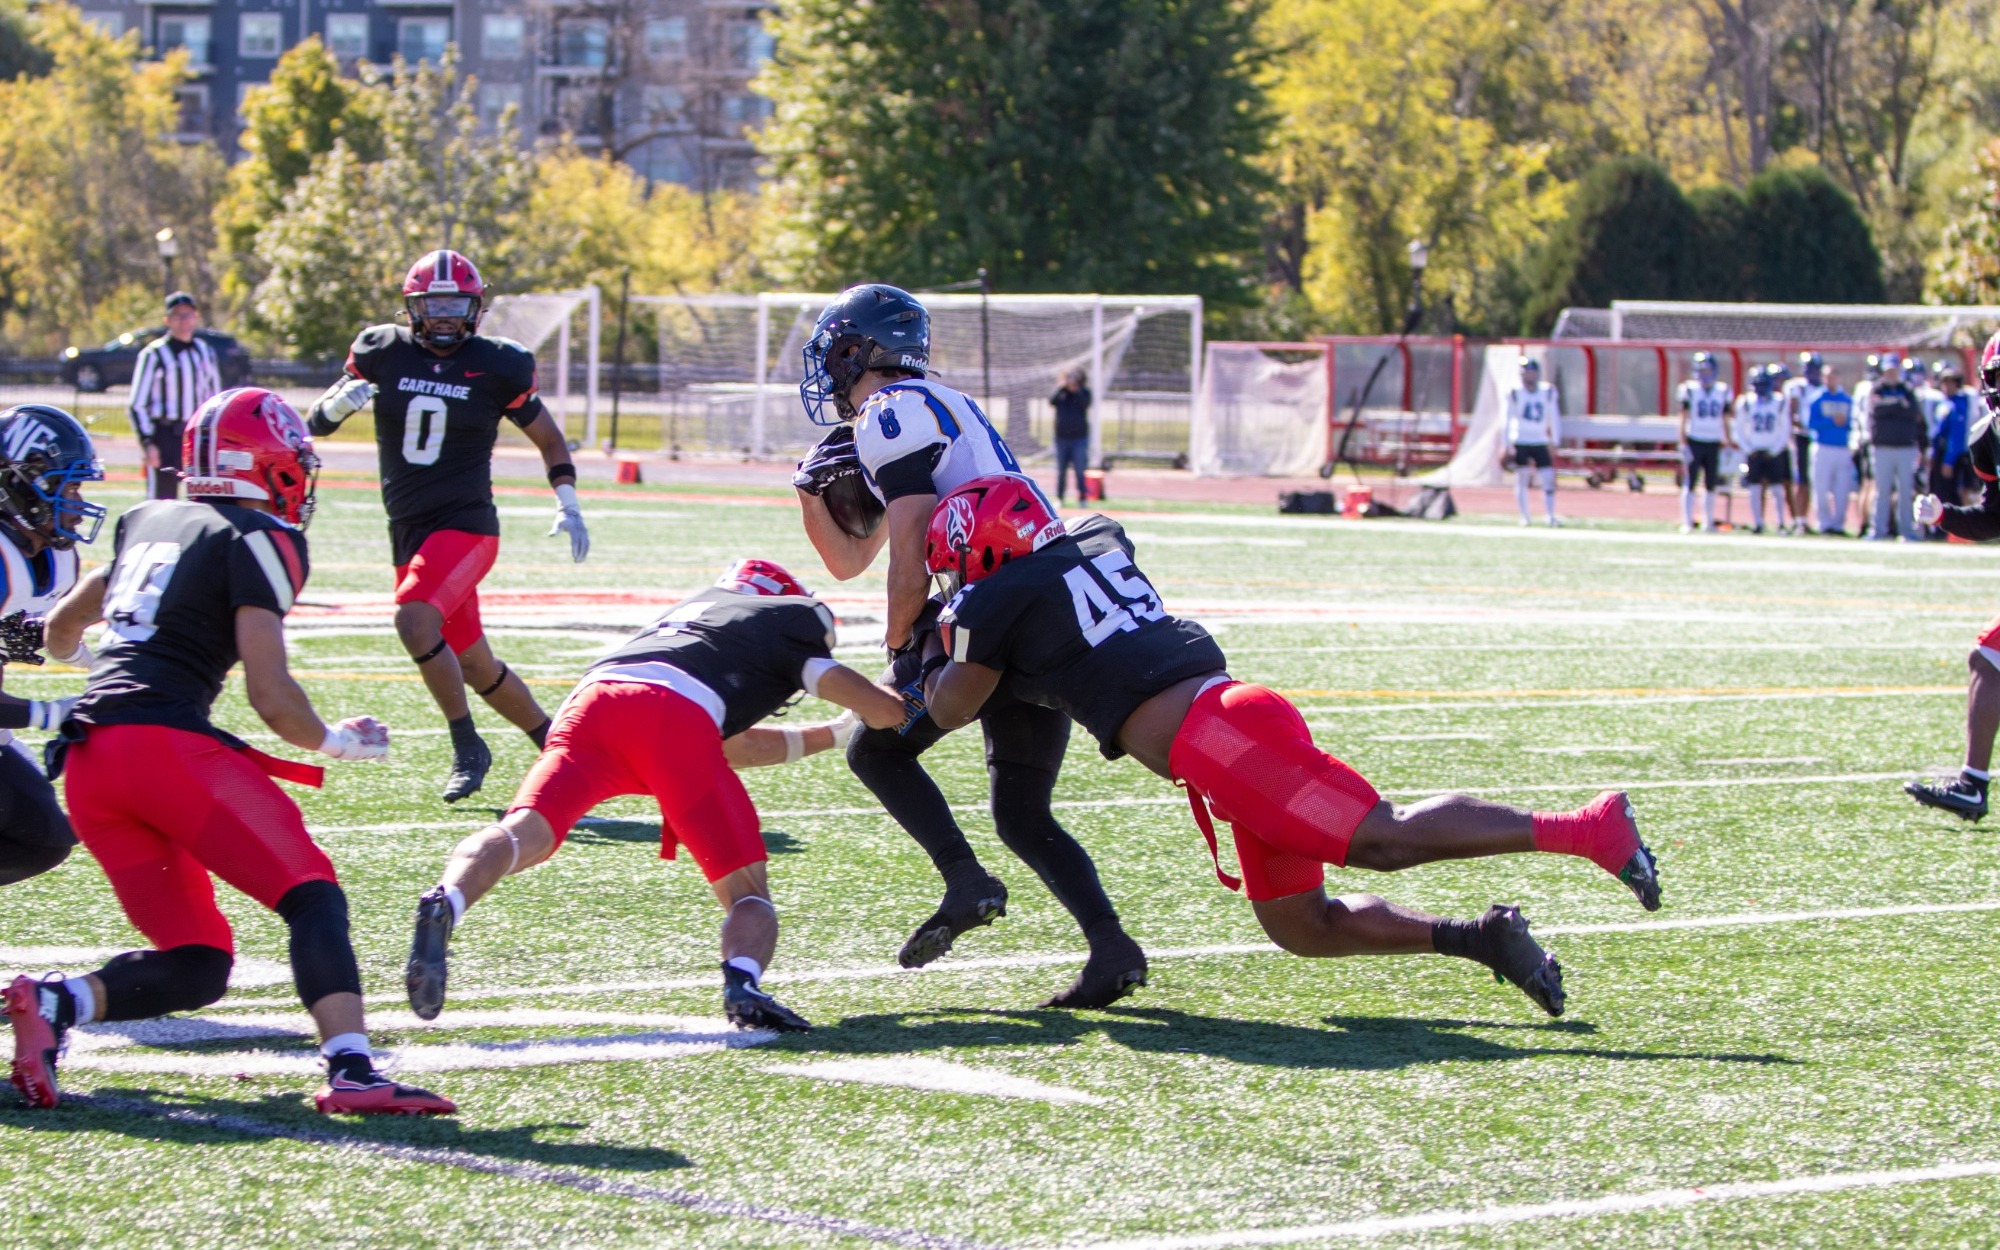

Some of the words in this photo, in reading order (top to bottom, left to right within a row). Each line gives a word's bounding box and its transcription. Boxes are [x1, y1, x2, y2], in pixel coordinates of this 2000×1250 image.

[398, 377, 471, 400] CARTHAGE
[402, 394, 448, 466] 0
[878, 407, 902, 440] 8
[1062, 548, 1168, 648] 45
